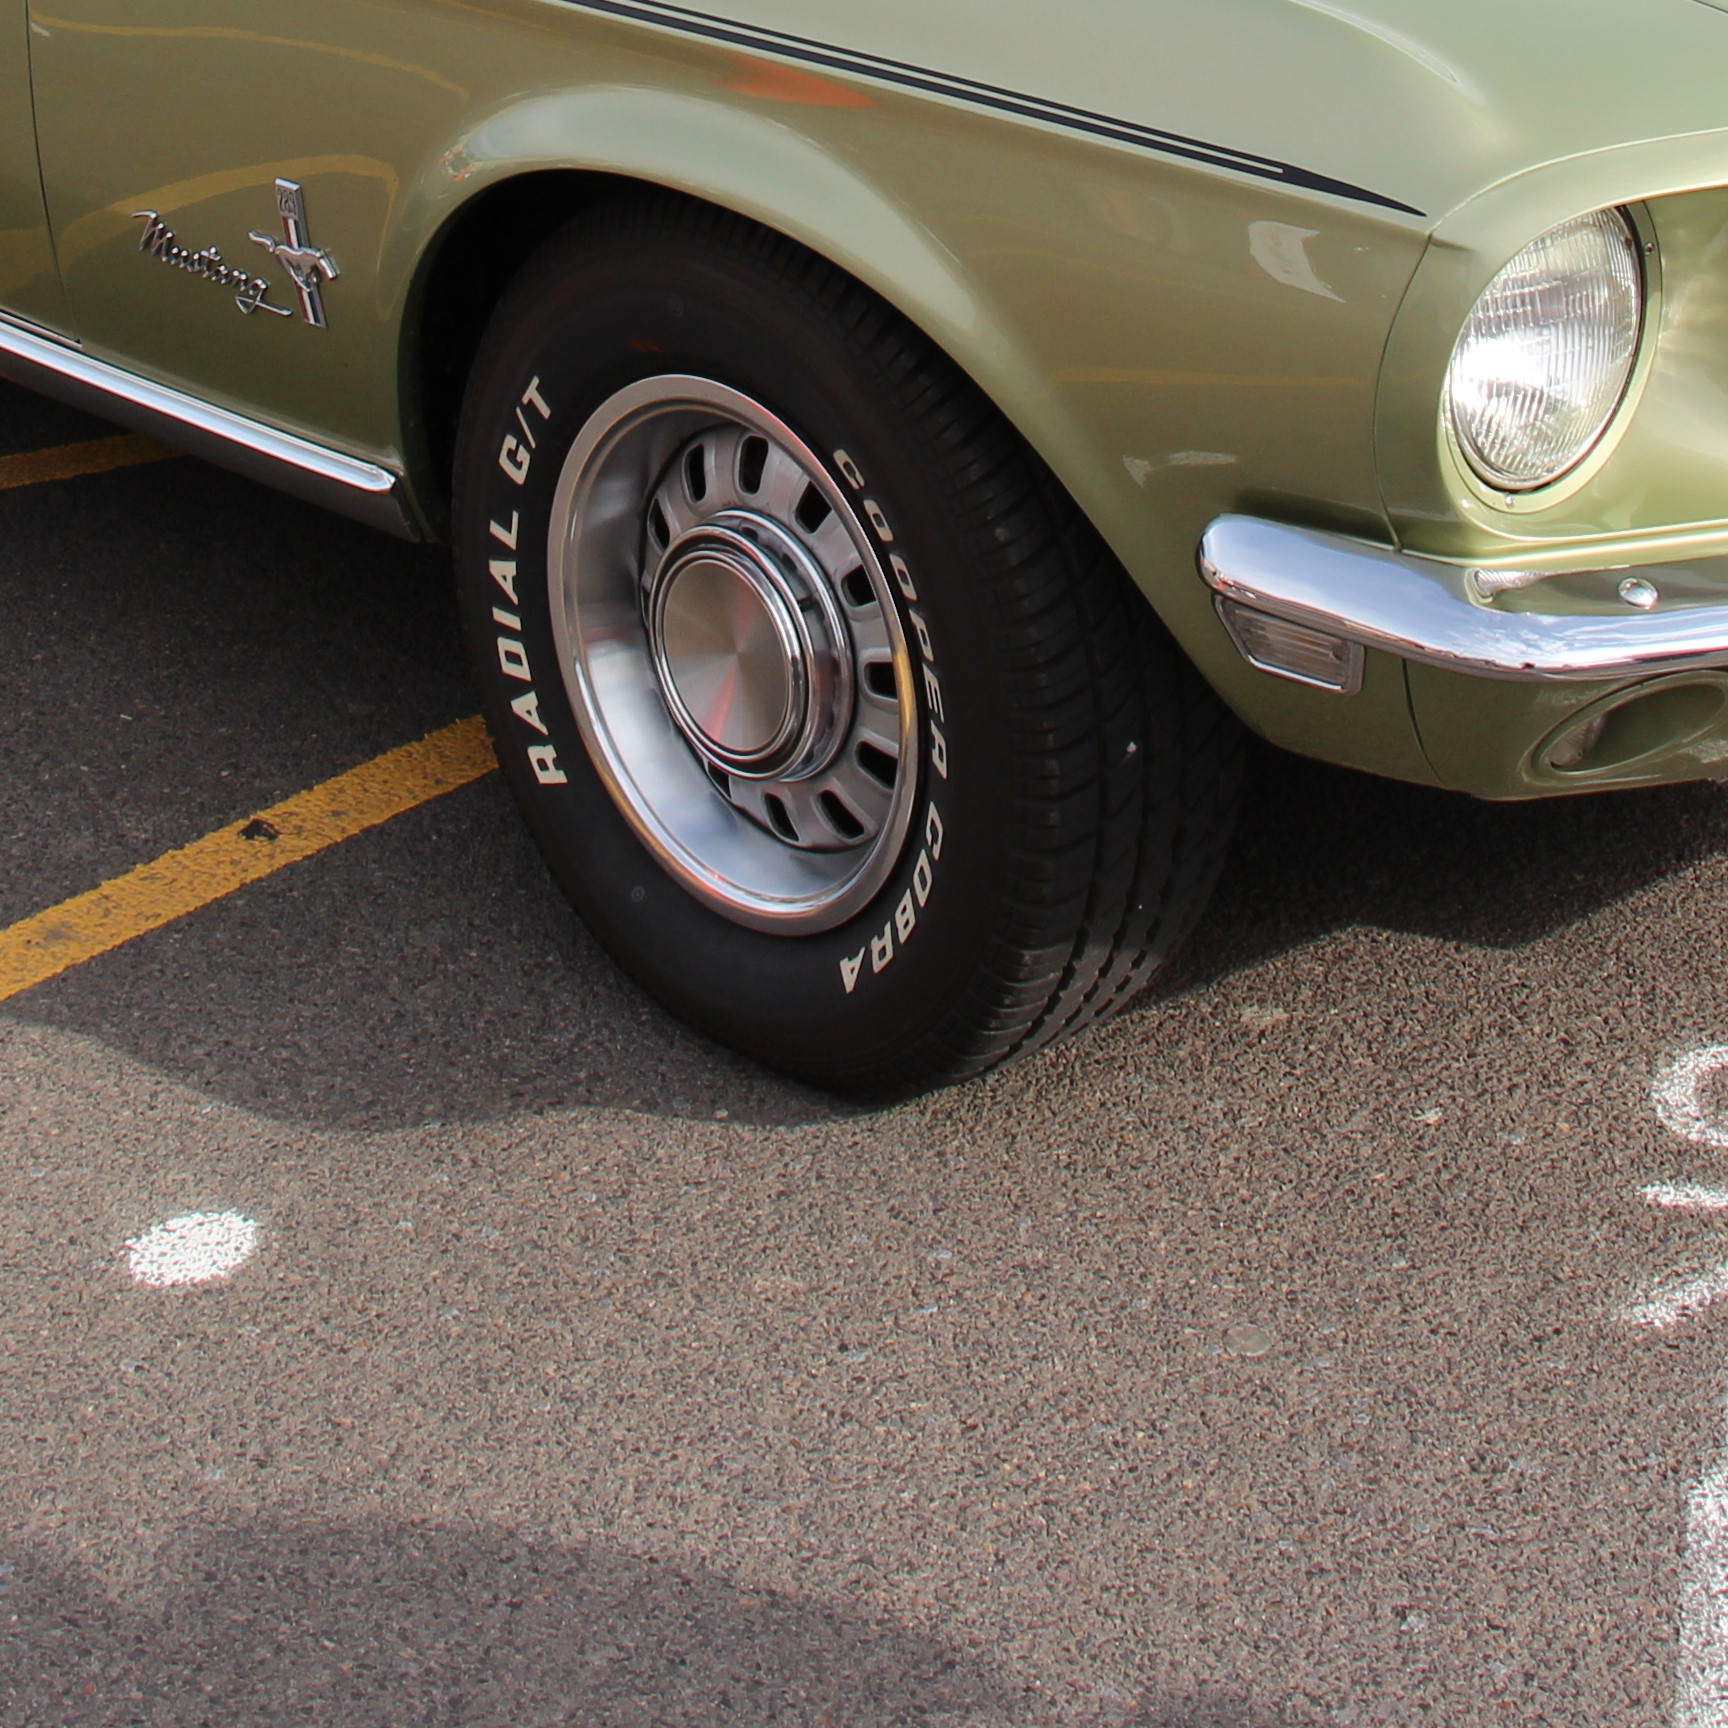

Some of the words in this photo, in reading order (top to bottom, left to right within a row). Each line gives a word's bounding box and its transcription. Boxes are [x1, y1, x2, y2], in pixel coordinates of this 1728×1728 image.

[132, 209, 293, 315] Mustang
[498, 375, 552, 485] G/T
[489, 510, 568, 785] RADIAL
[832, 448, 948, 780] COOPER
[839, 800, 944, 994] COBRA
